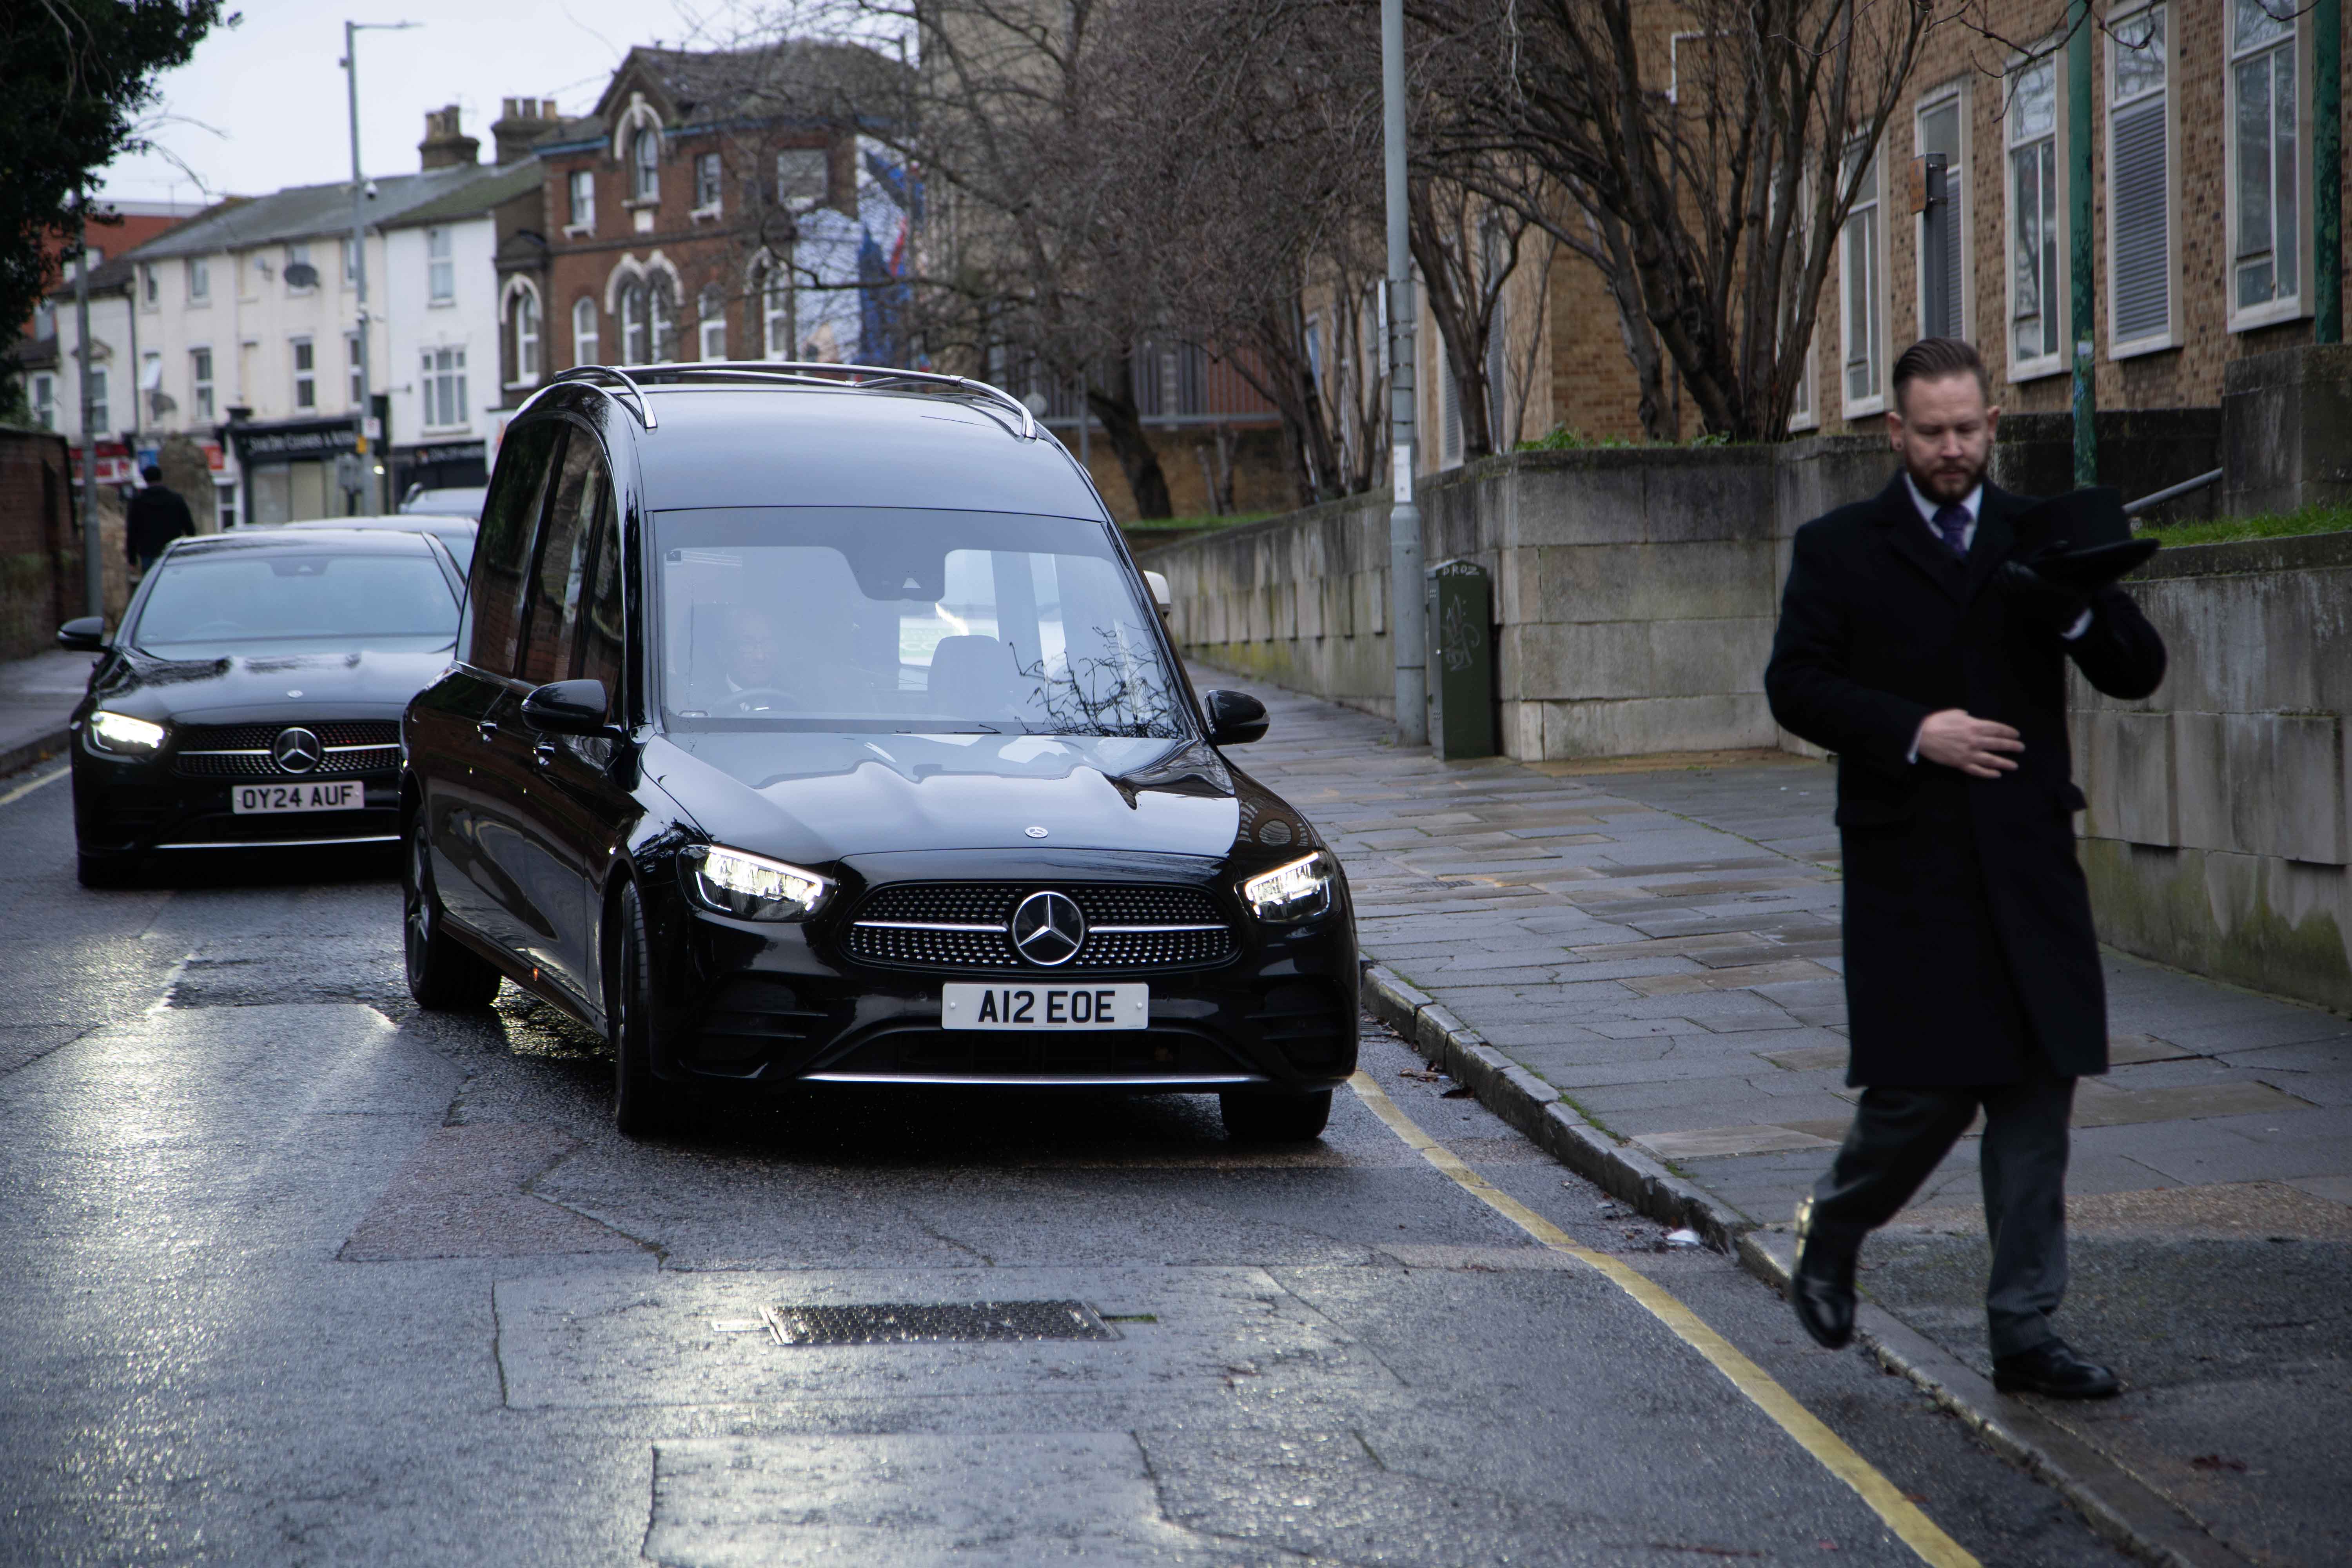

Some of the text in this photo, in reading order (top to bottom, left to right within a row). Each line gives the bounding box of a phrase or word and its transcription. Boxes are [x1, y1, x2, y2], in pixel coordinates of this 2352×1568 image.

[243, 785, 353, 809] OY24 AUF
[978, 990, 1116, 1023] A12 EOE
